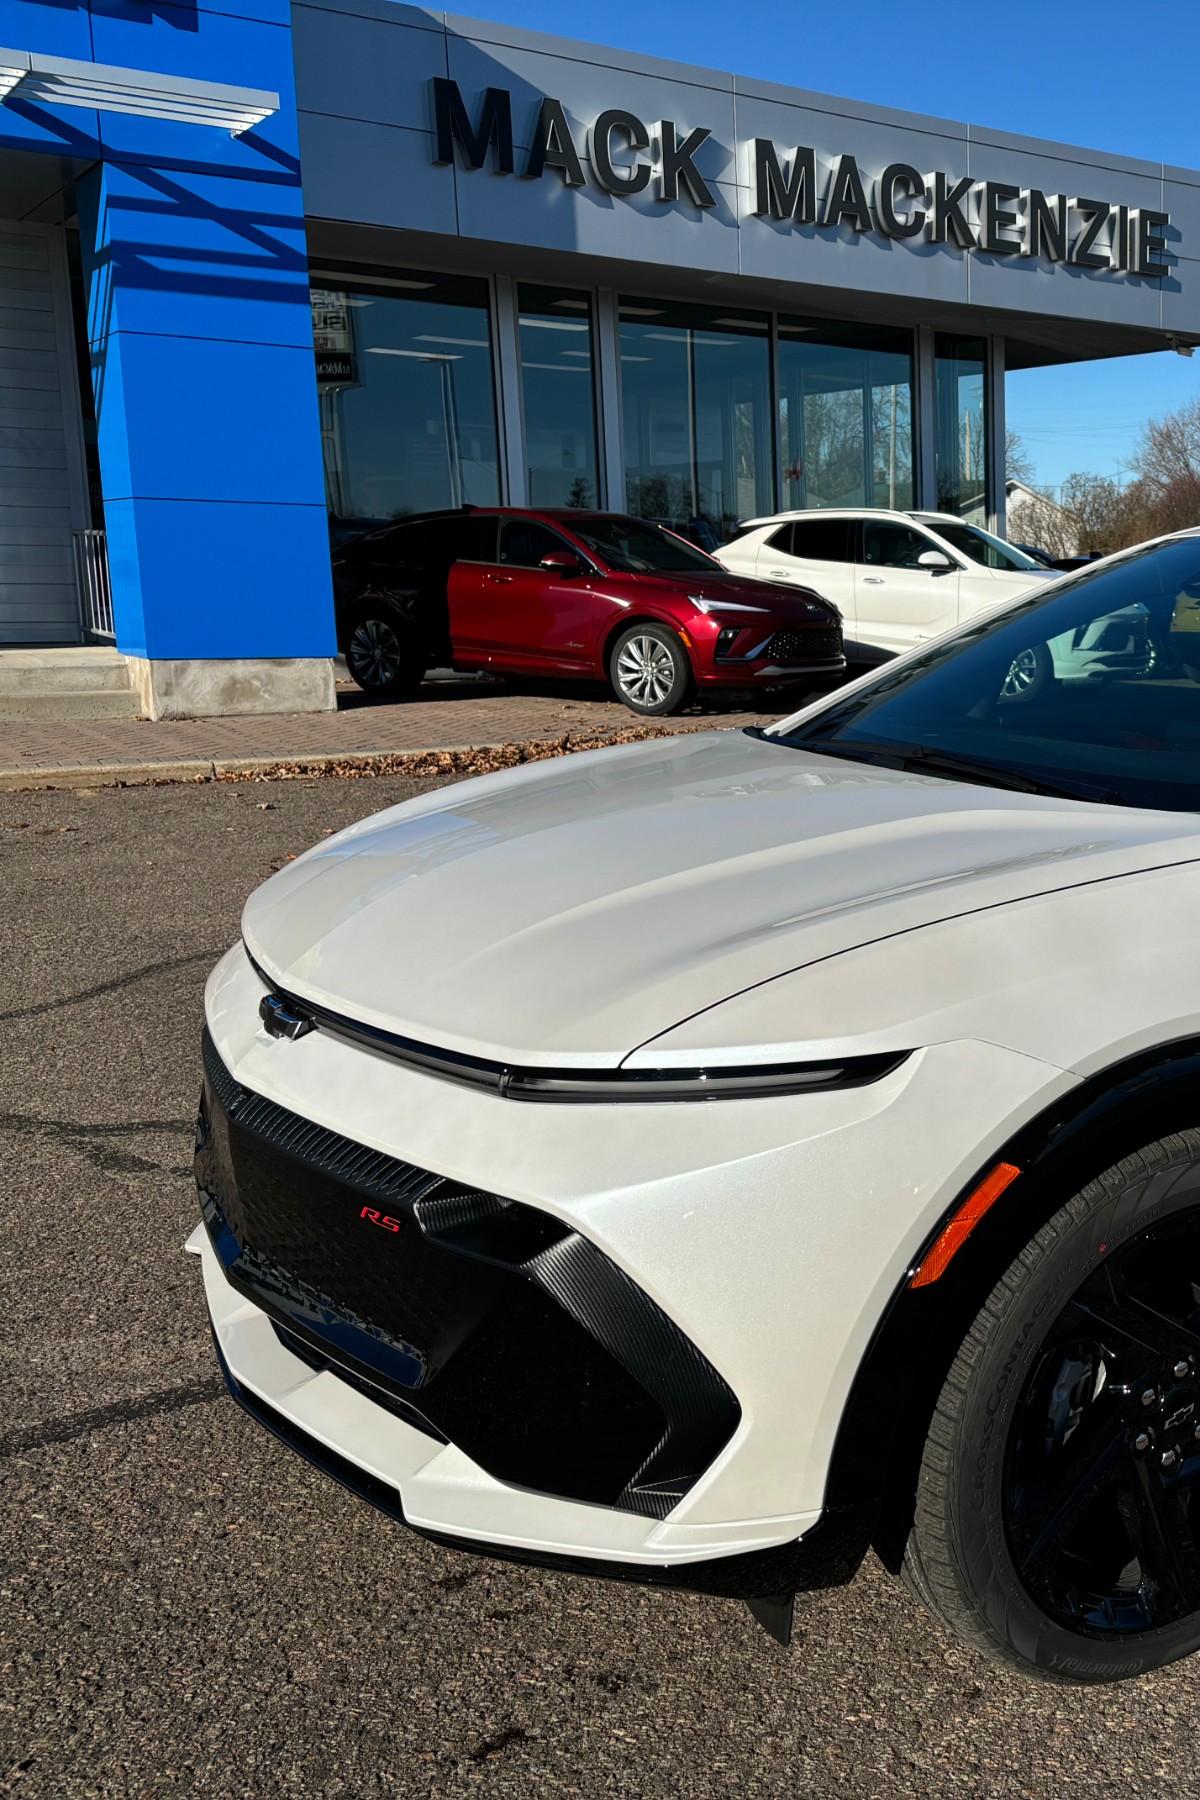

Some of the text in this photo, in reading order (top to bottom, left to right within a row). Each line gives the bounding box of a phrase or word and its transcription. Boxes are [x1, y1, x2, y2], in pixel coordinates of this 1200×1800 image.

[428, 77, 1171, 277] MACK MACKENZIE
[360, 1206, 401, 1232] RS
